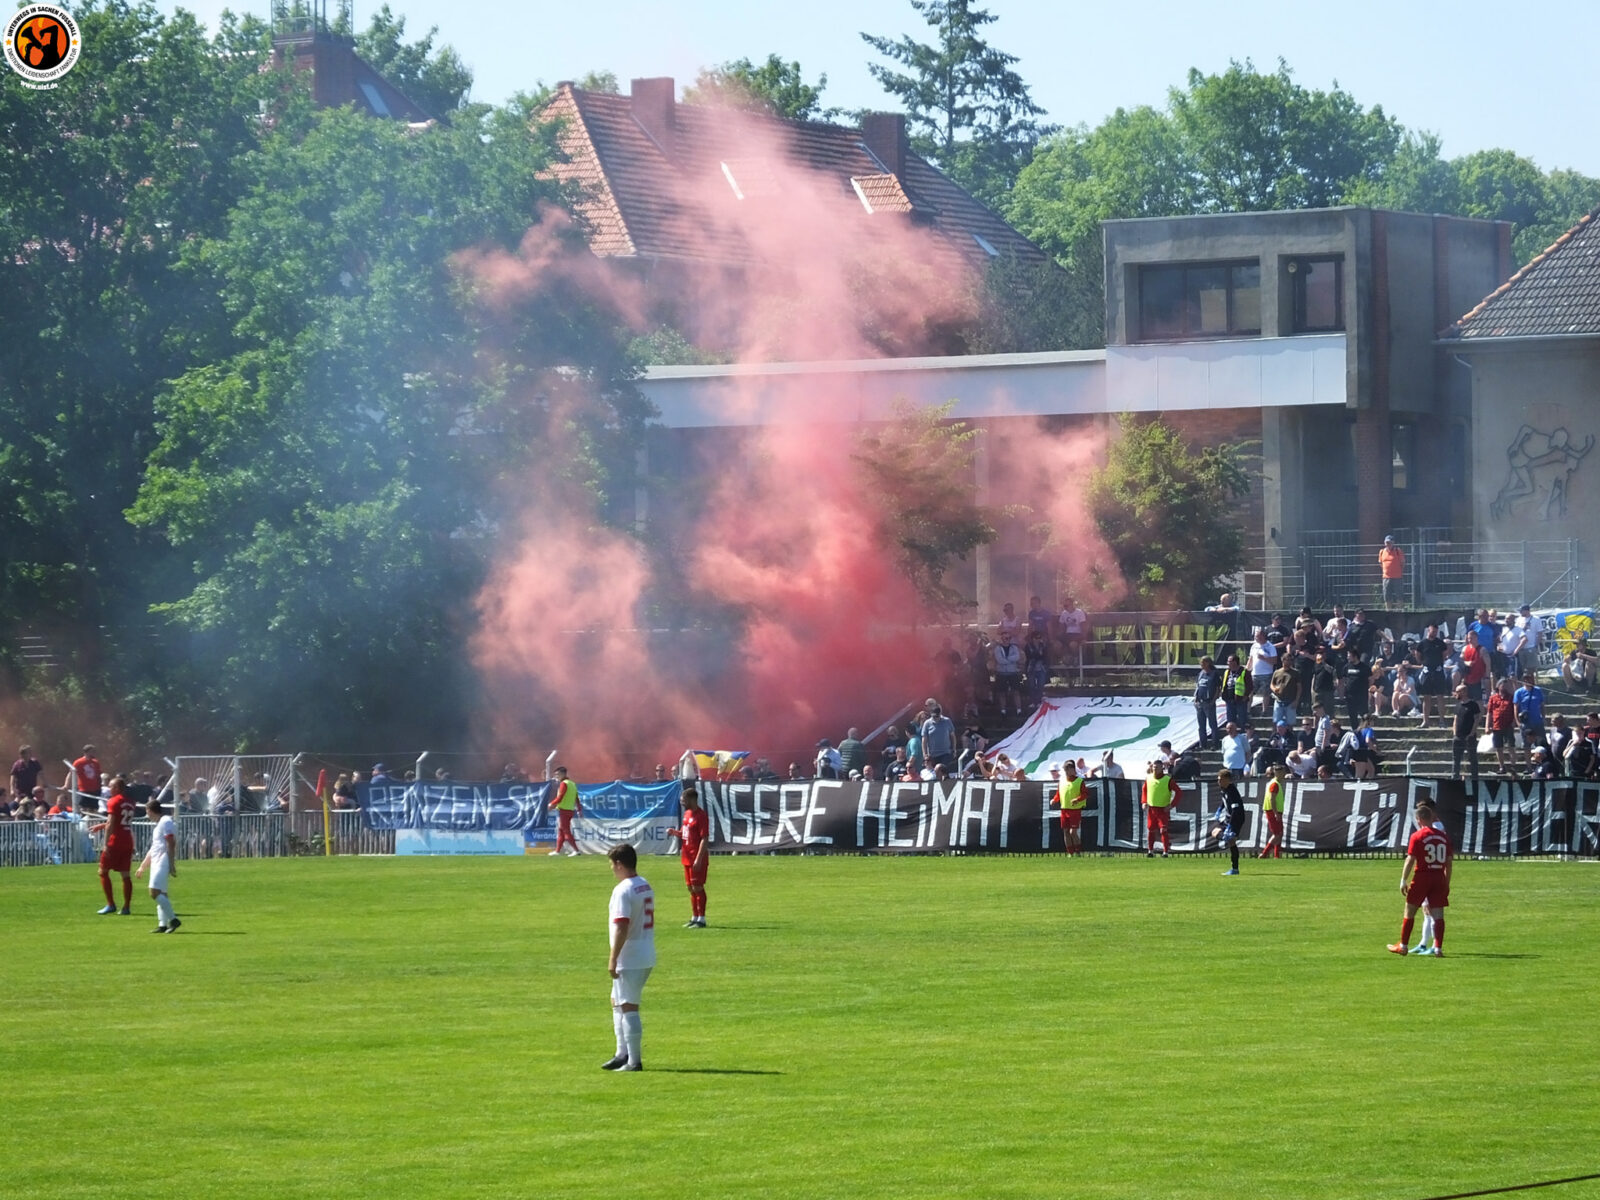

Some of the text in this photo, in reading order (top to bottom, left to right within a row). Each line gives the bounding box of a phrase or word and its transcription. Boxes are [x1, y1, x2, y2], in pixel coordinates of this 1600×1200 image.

[580, 794, 665, 811] URSTIGE
[1424, 843, 1447, 864] 30
[643, 897, 654, 929] 5
